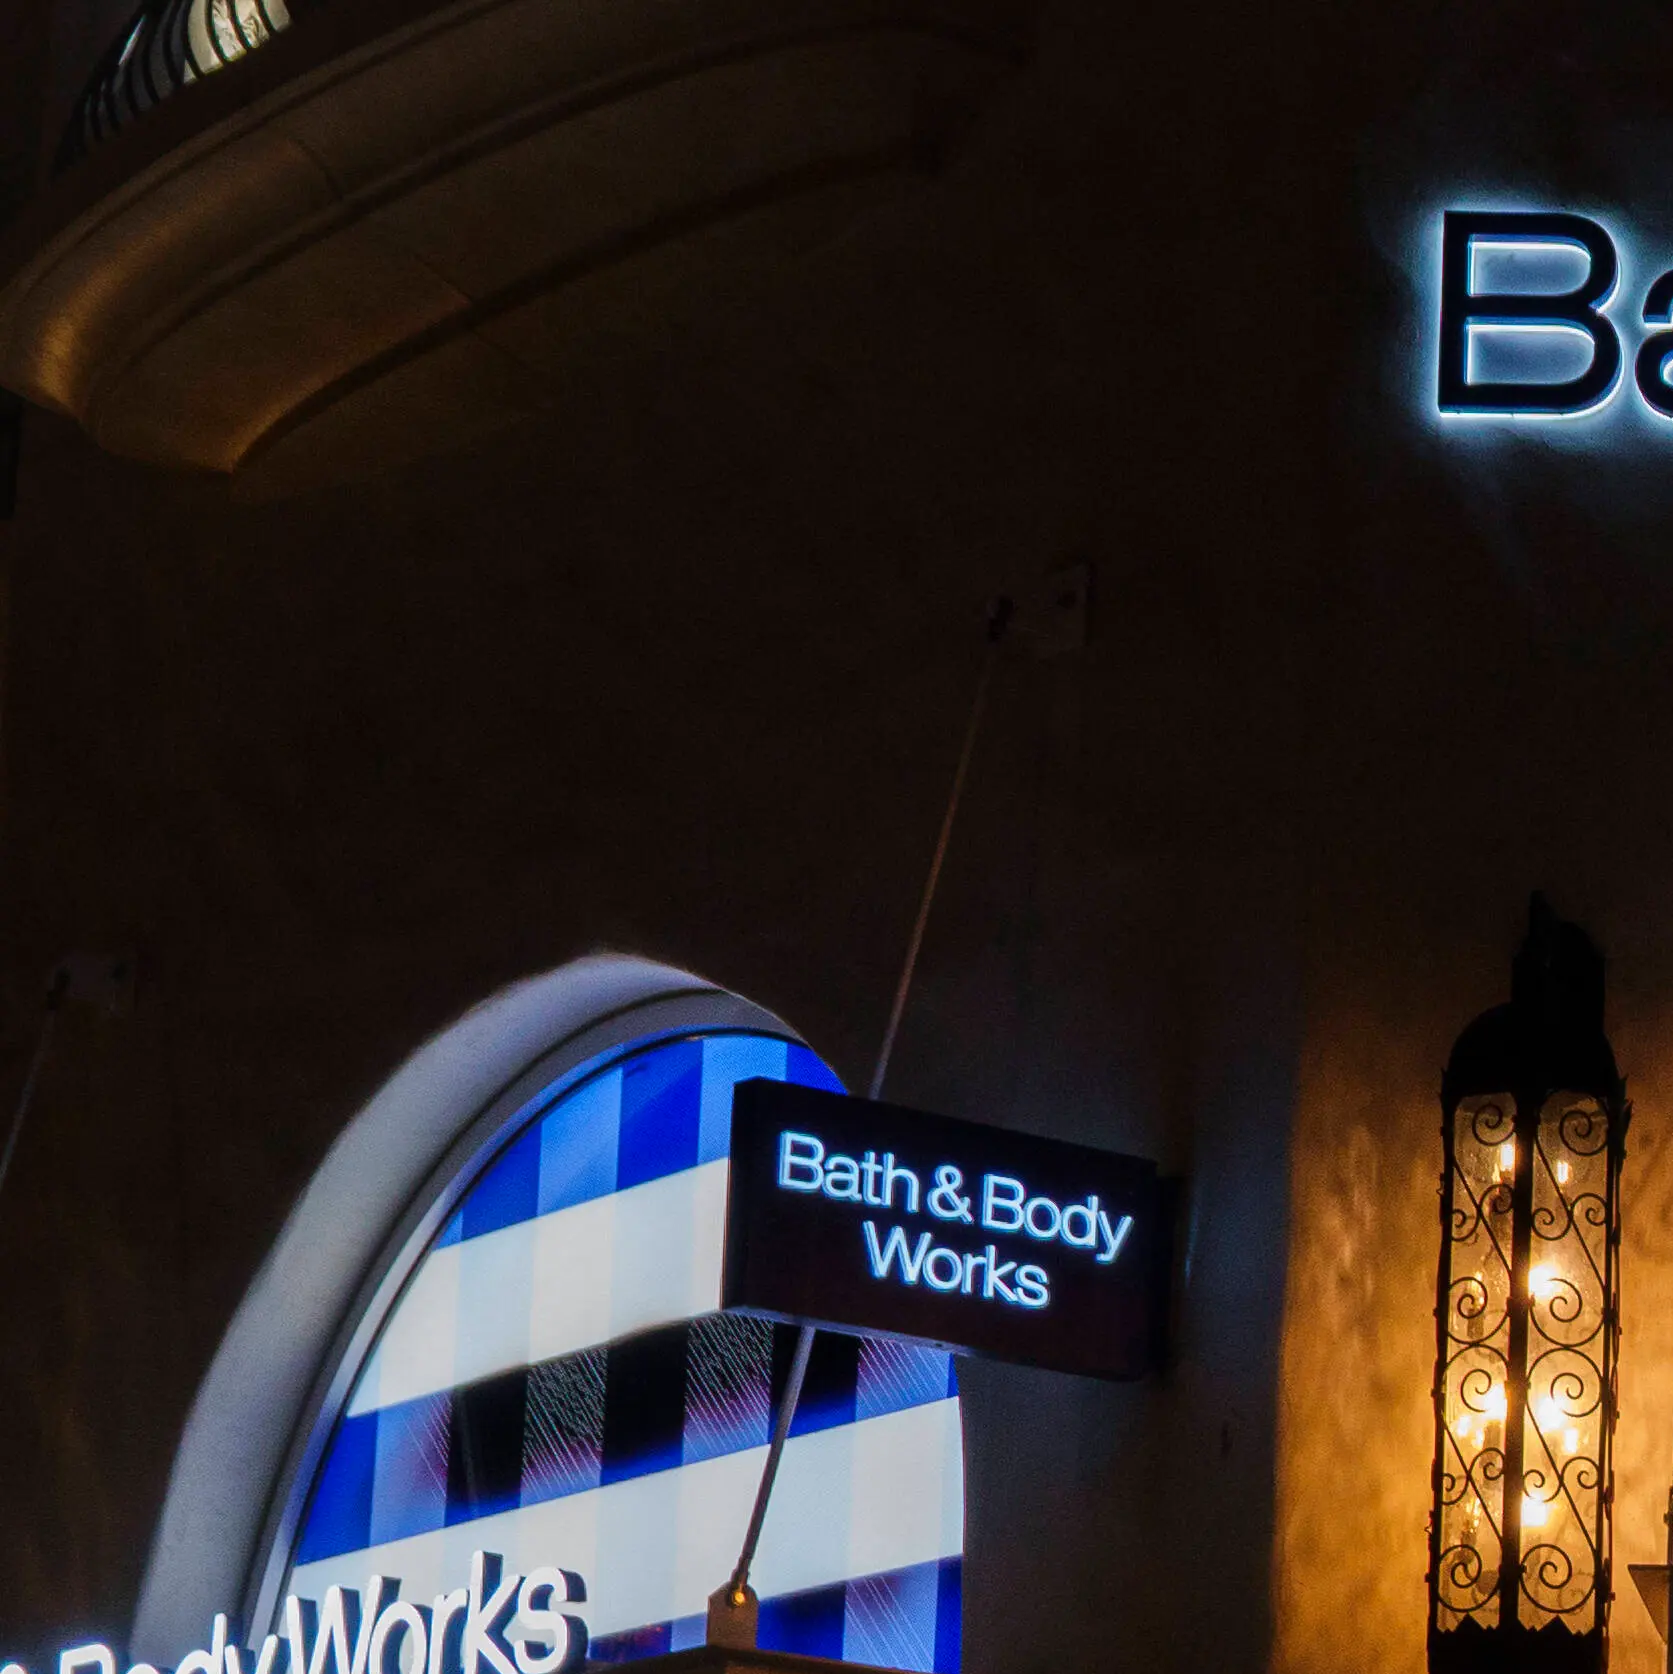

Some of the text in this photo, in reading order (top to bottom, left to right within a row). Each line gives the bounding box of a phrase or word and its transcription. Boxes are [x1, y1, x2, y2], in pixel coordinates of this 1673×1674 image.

[778, 1131, 1133, 1263] Bath & Body
[863, 1221, 1050, 1309] Works
